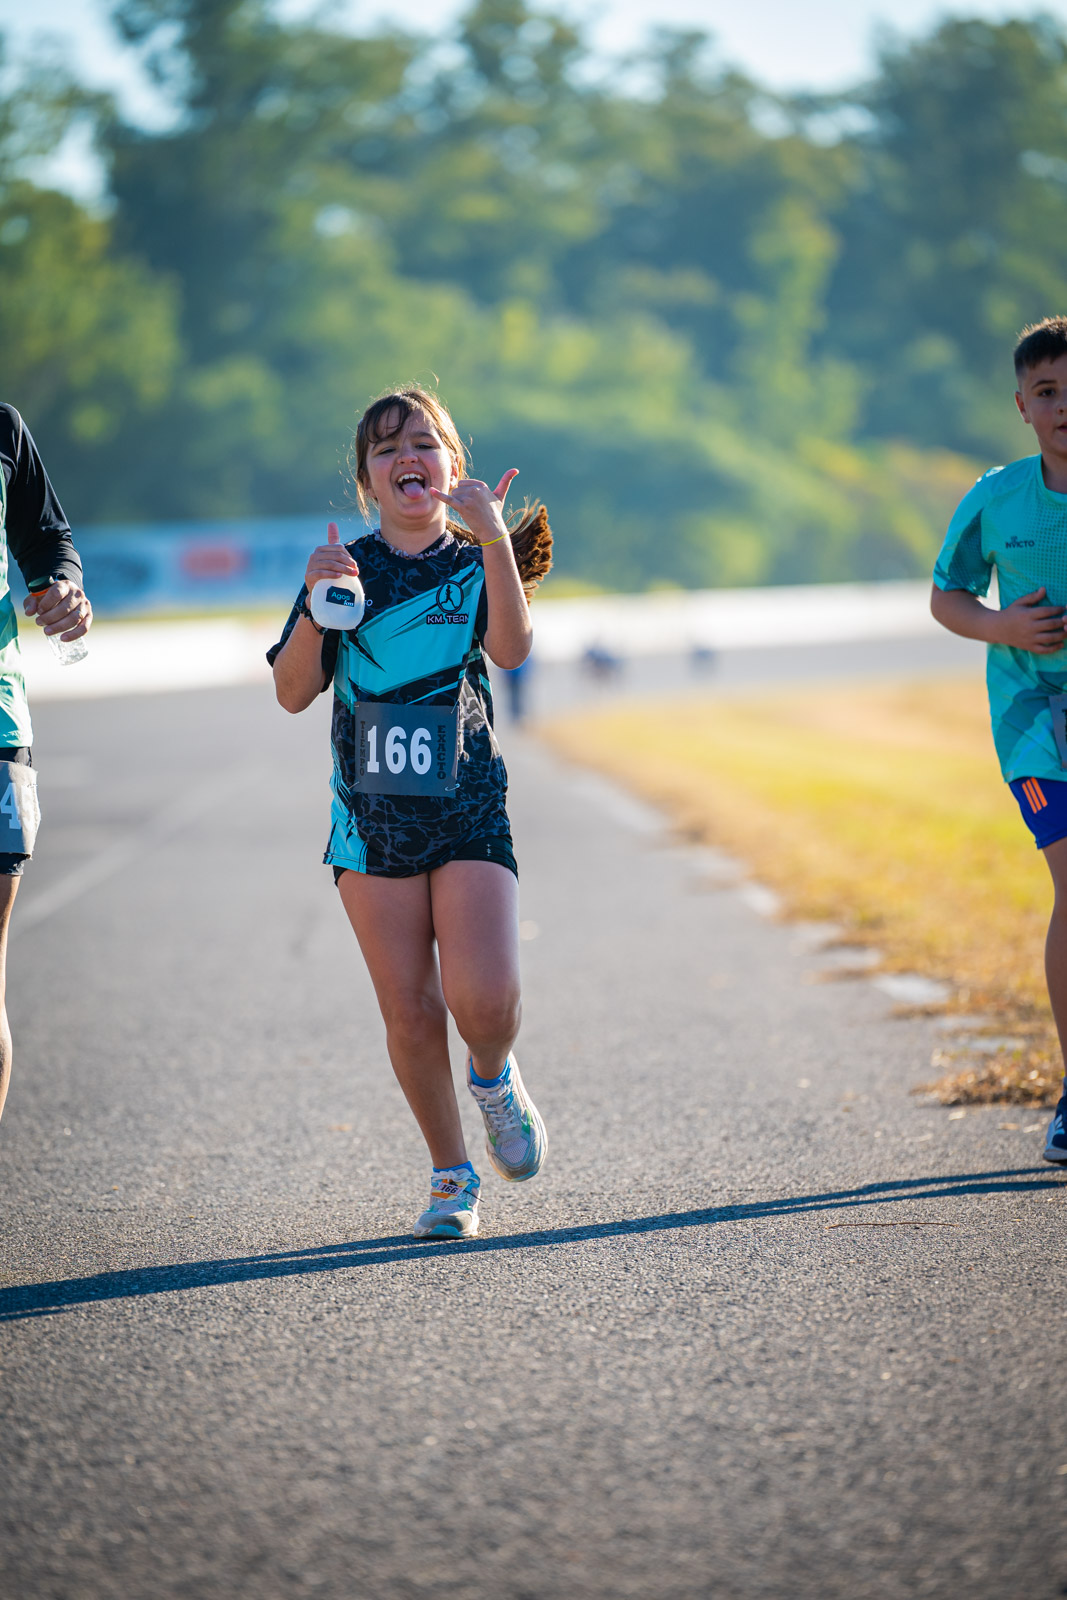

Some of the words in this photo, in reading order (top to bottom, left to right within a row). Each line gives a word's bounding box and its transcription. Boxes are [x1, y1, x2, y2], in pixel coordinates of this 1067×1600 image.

[331, 591, 351, 601] Agos
[367, 725, 432, 775] 166
[437, 725, 446, 780] EXACTO
[440, 1184, 459, 1194] 166
